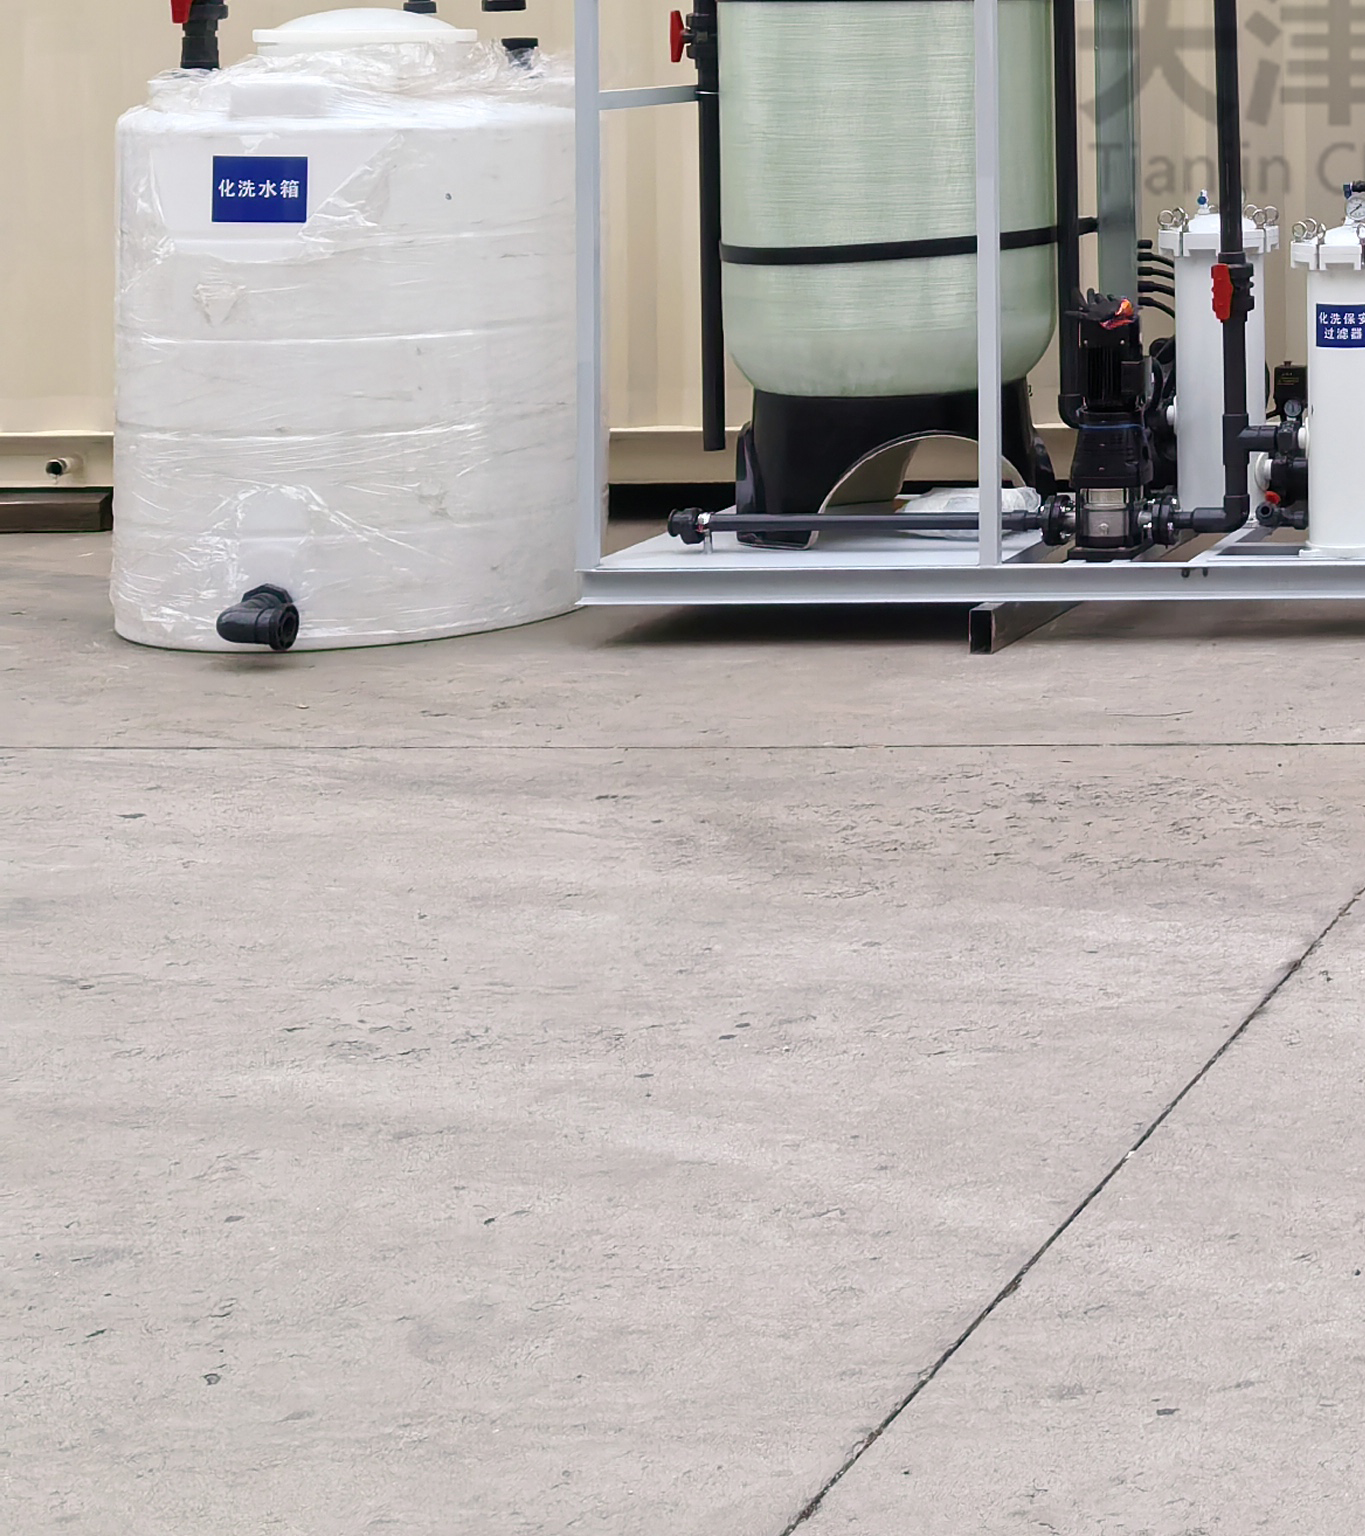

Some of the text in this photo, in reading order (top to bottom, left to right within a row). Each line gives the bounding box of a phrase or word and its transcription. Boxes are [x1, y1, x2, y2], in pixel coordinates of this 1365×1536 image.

[218, 178, 300, 198] 化洗水箱
[1324, 326, 1363, 340] 过滤器
